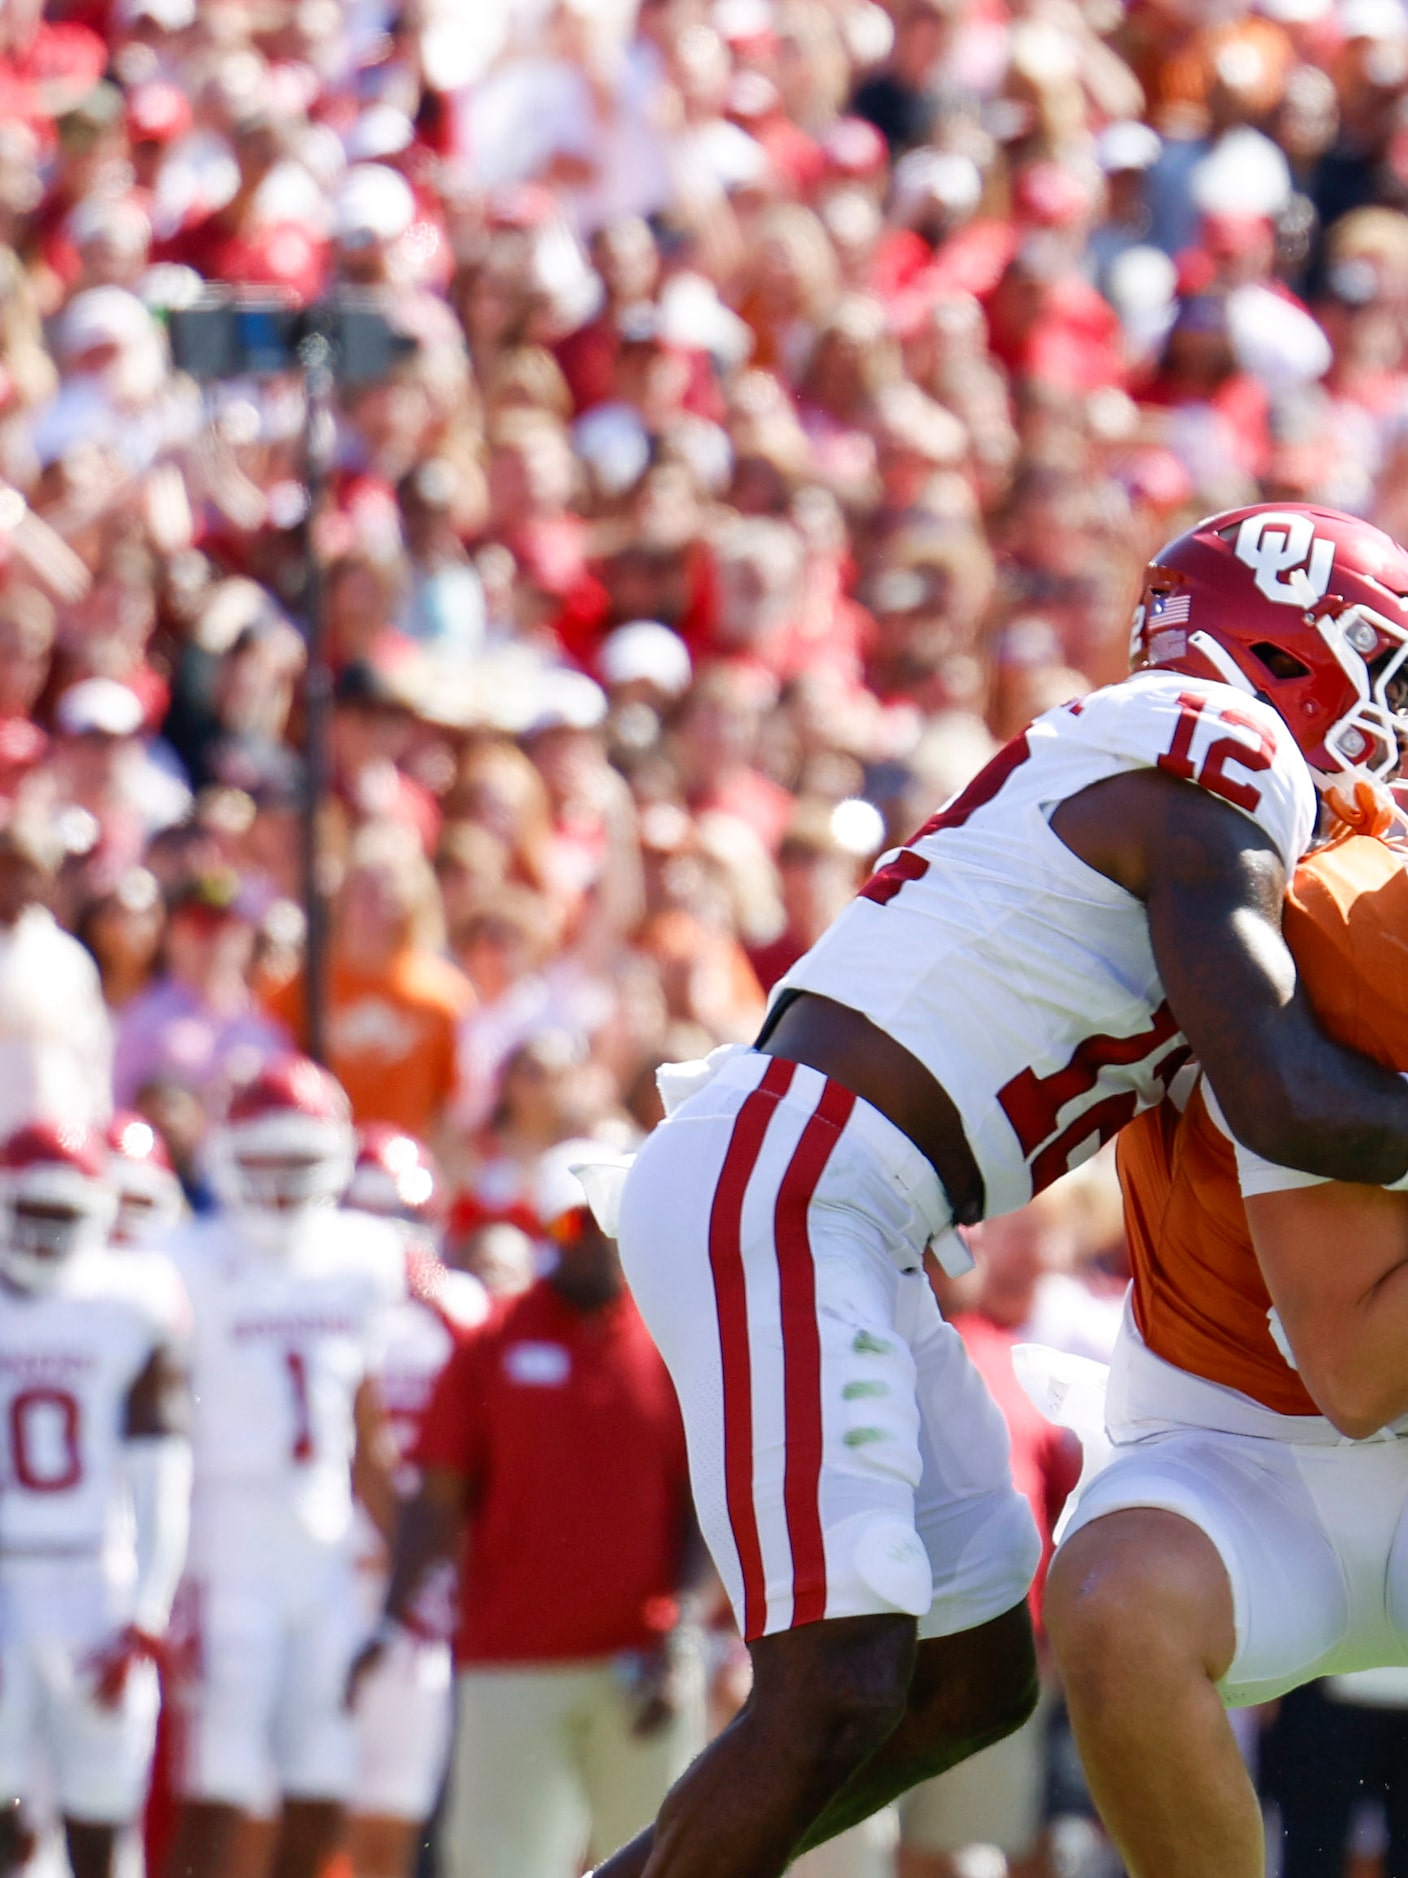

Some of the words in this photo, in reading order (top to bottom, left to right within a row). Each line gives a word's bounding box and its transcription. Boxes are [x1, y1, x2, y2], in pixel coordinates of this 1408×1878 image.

[1234, 511, 1336, 611] OU
[1157, 691, 1277, 813] 12
[9, 1386, 86, 1493] 0
[284, 1350, 314, 1464] 1
